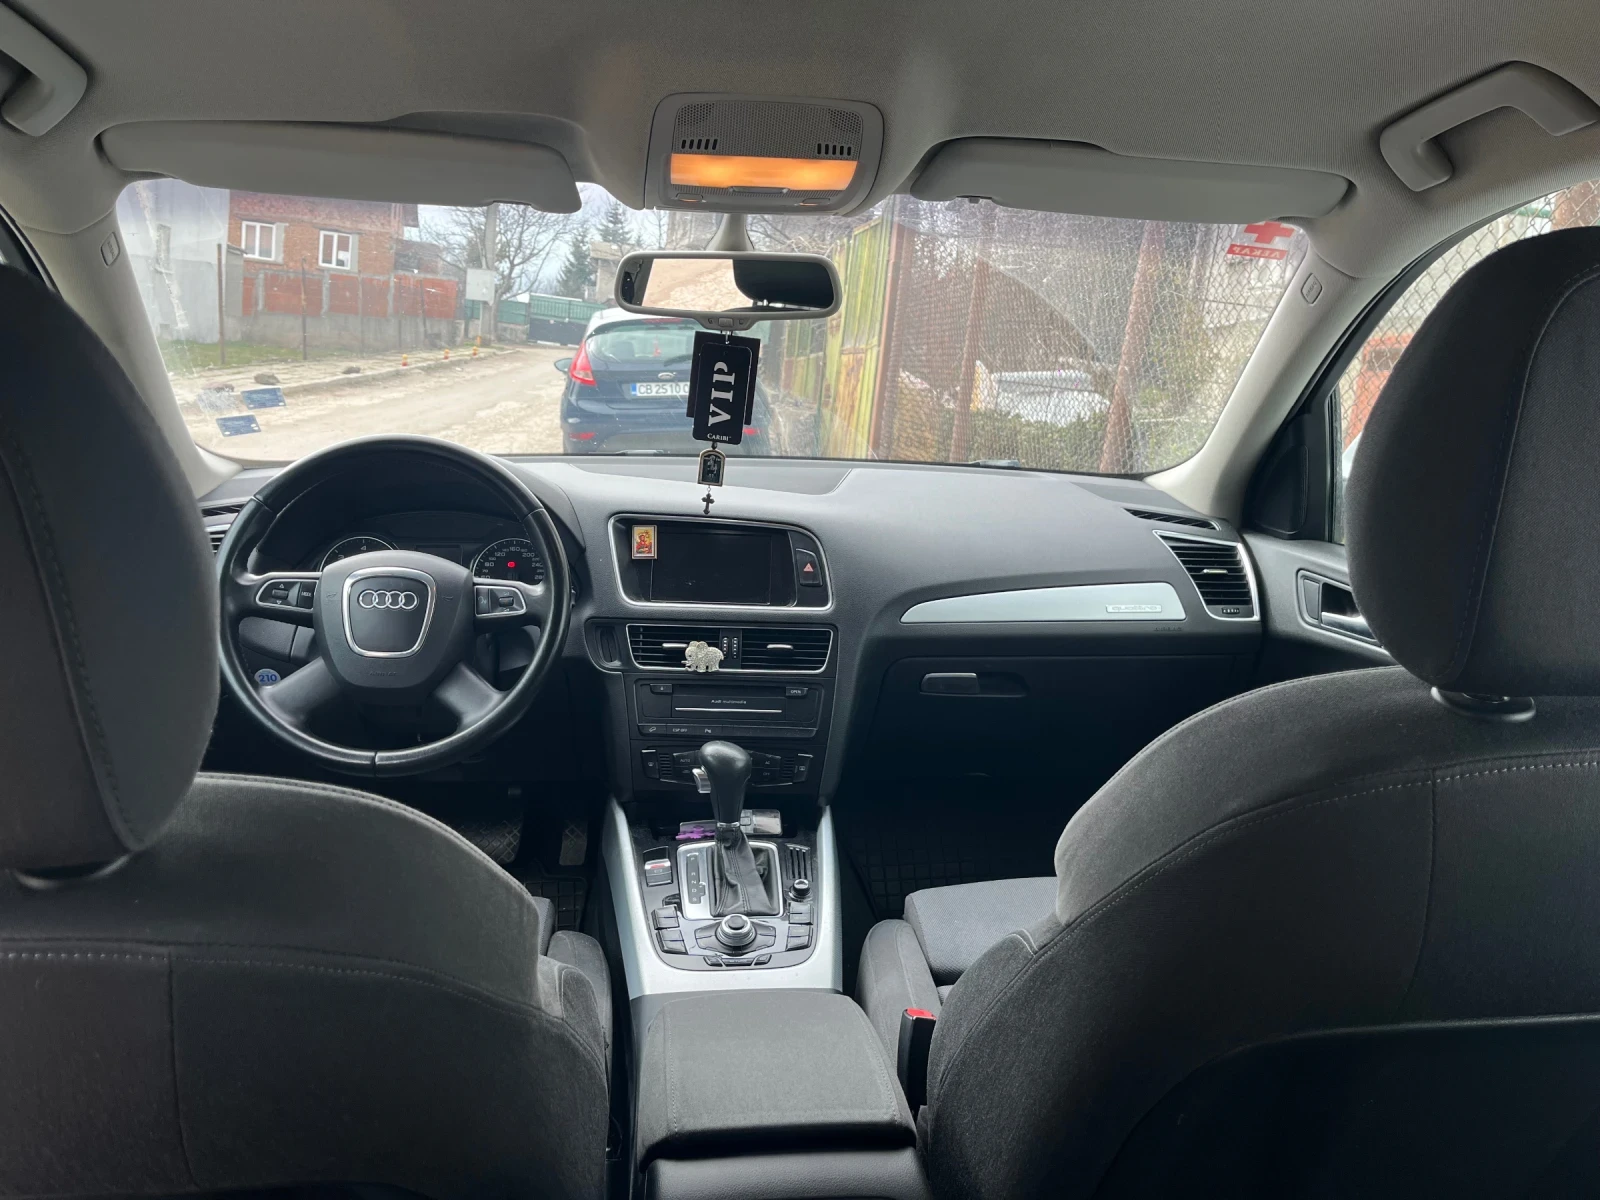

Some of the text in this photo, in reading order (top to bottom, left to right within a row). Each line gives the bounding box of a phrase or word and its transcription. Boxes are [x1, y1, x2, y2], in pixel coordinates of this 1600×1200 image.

[638, 384, 653, 395] CB
[655, 383, 681, 395] 2510
[708, 361, 736, 427] VIP
[258, 674, 278, 682] 210
